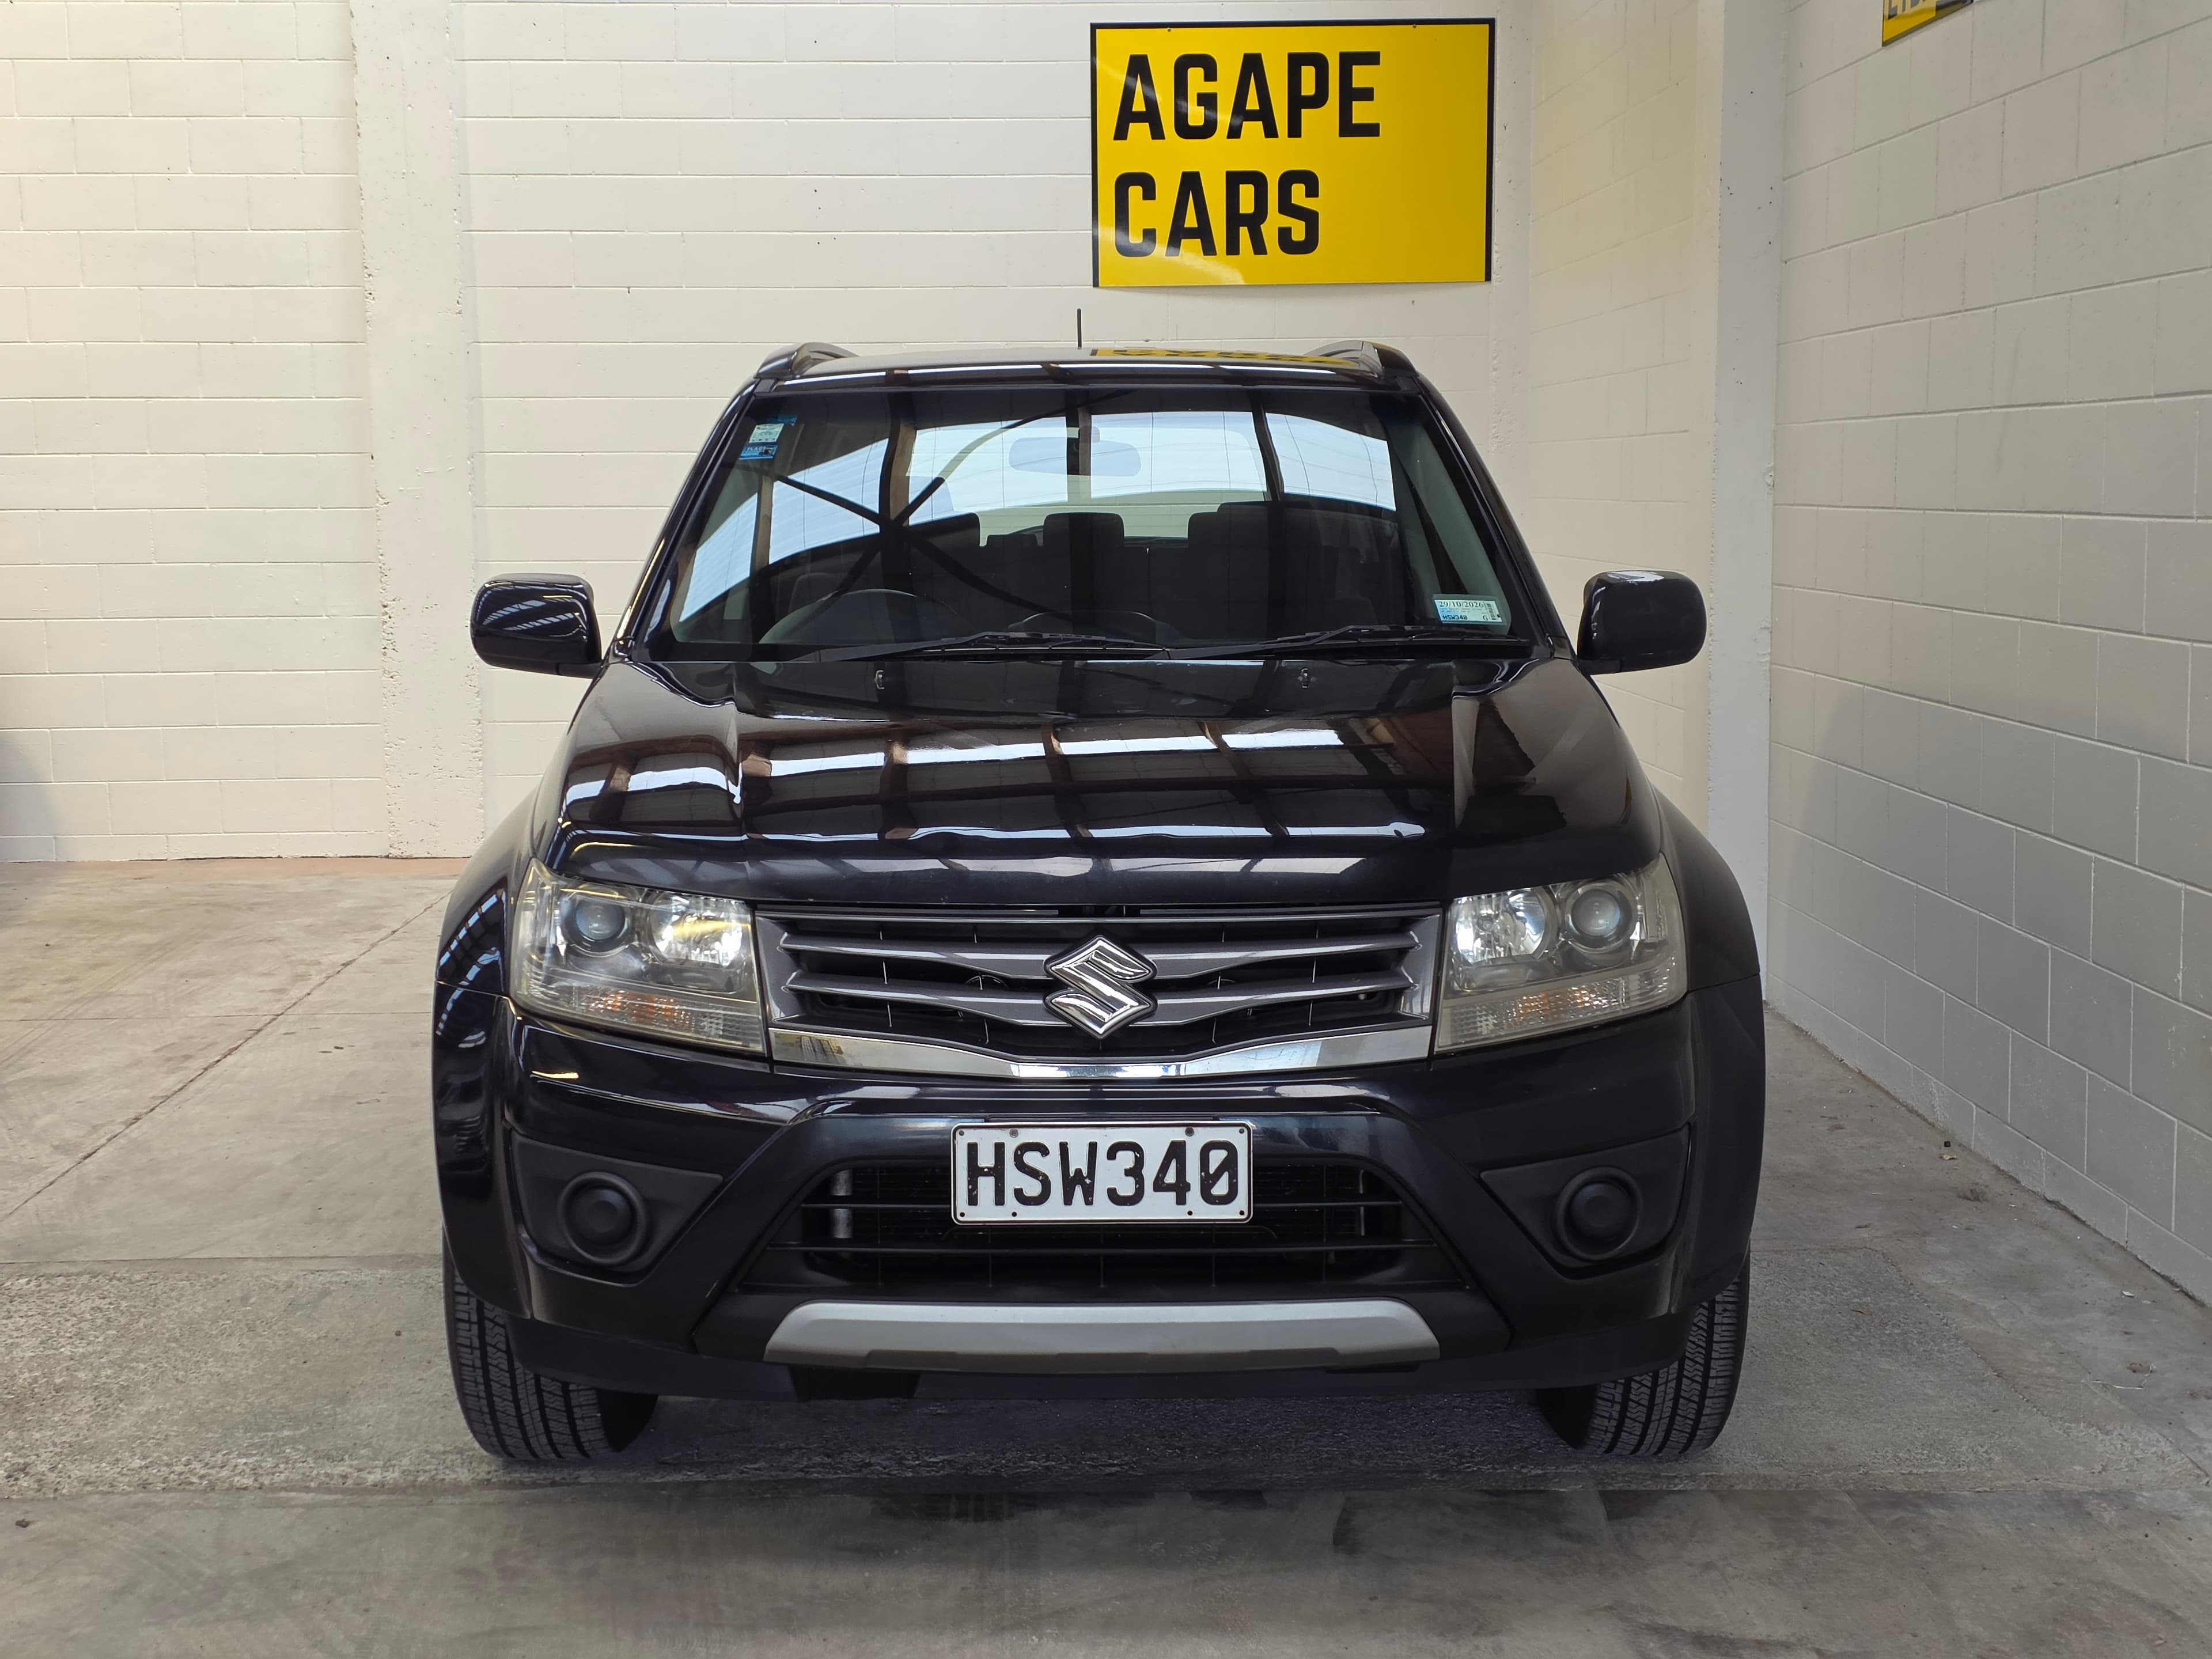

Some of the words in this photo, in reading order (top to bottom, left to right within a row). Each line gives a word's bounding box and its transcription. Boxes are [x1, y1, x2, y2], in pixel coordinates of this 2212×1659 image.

[1112, 50, 1381, 141] AGAPE
[1114, 169, 1320, 257] CARS
[967, 1139, 1238, 1206] HSW340
